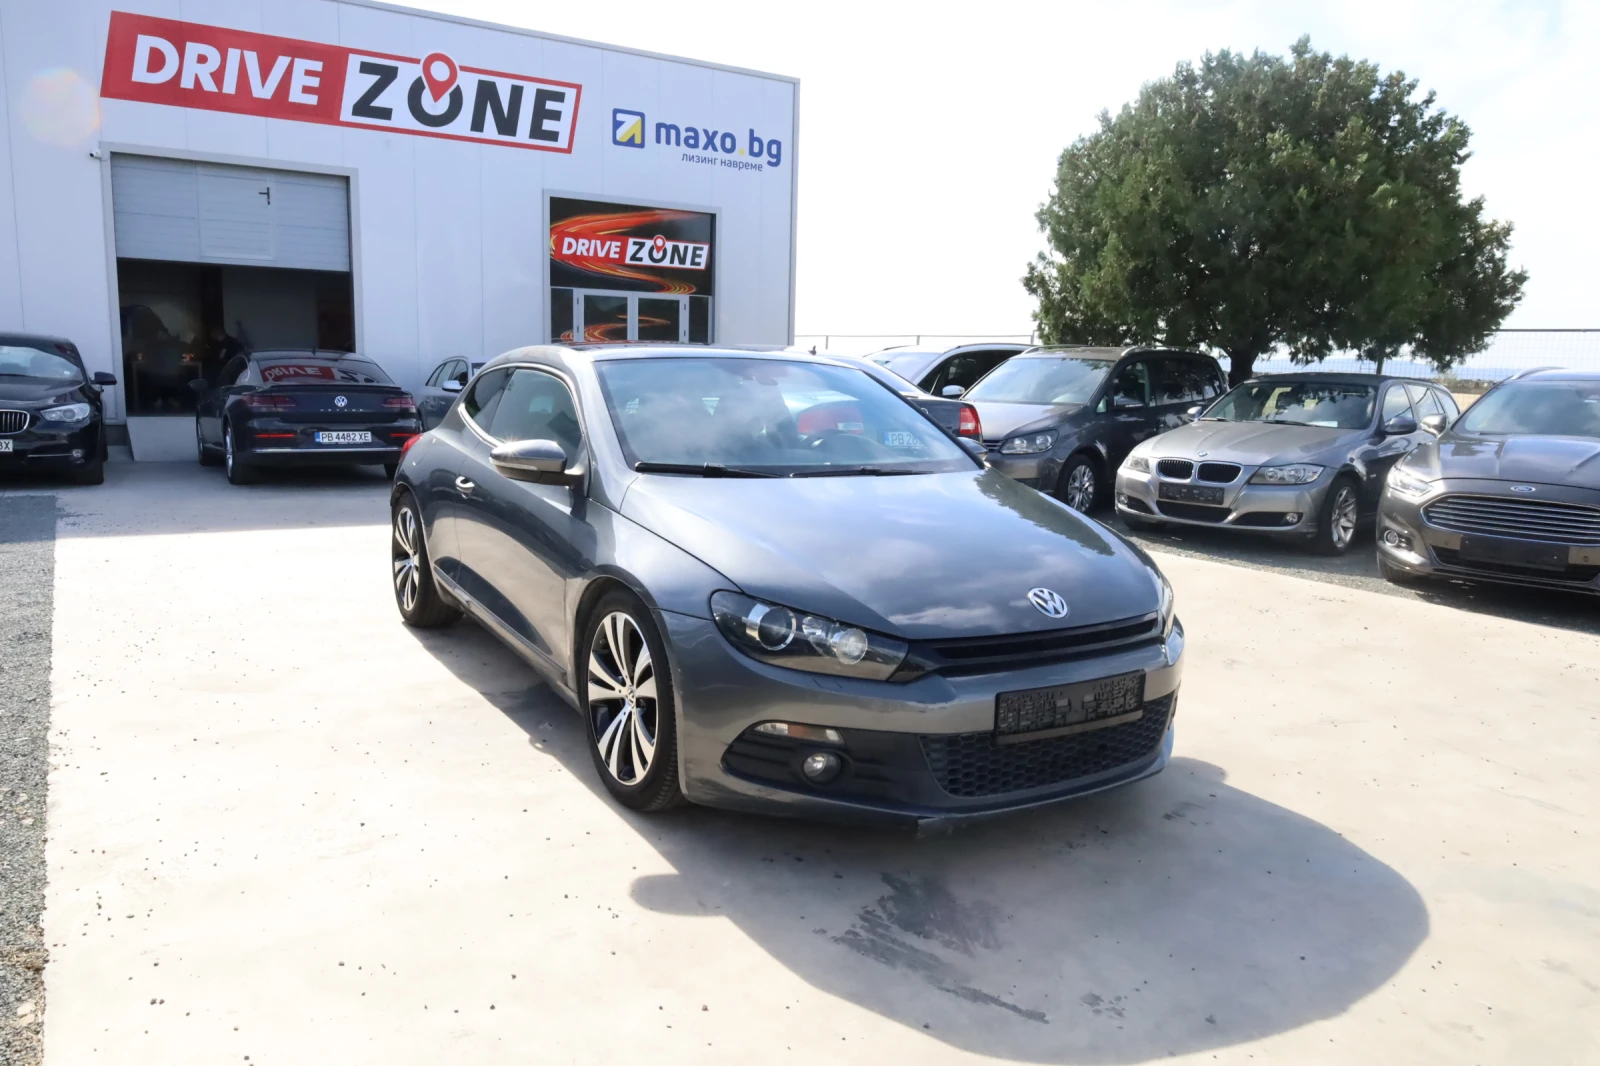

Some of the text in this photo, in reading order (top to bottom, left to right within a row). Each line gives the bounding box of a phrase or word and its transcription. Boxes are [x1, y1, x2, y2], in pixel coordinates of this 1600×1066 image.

[131, 34, 566, 142] DRIVE ZONE
[655, 122, 782, 167] maxo.bg
[682, 153, 763, 171] лизинг навреме
[562, 237, 704, 267] DRIVE ZONE
[321, 432, 370, 441] PB 4482 XE
[890, 433, 904, 445] PB
